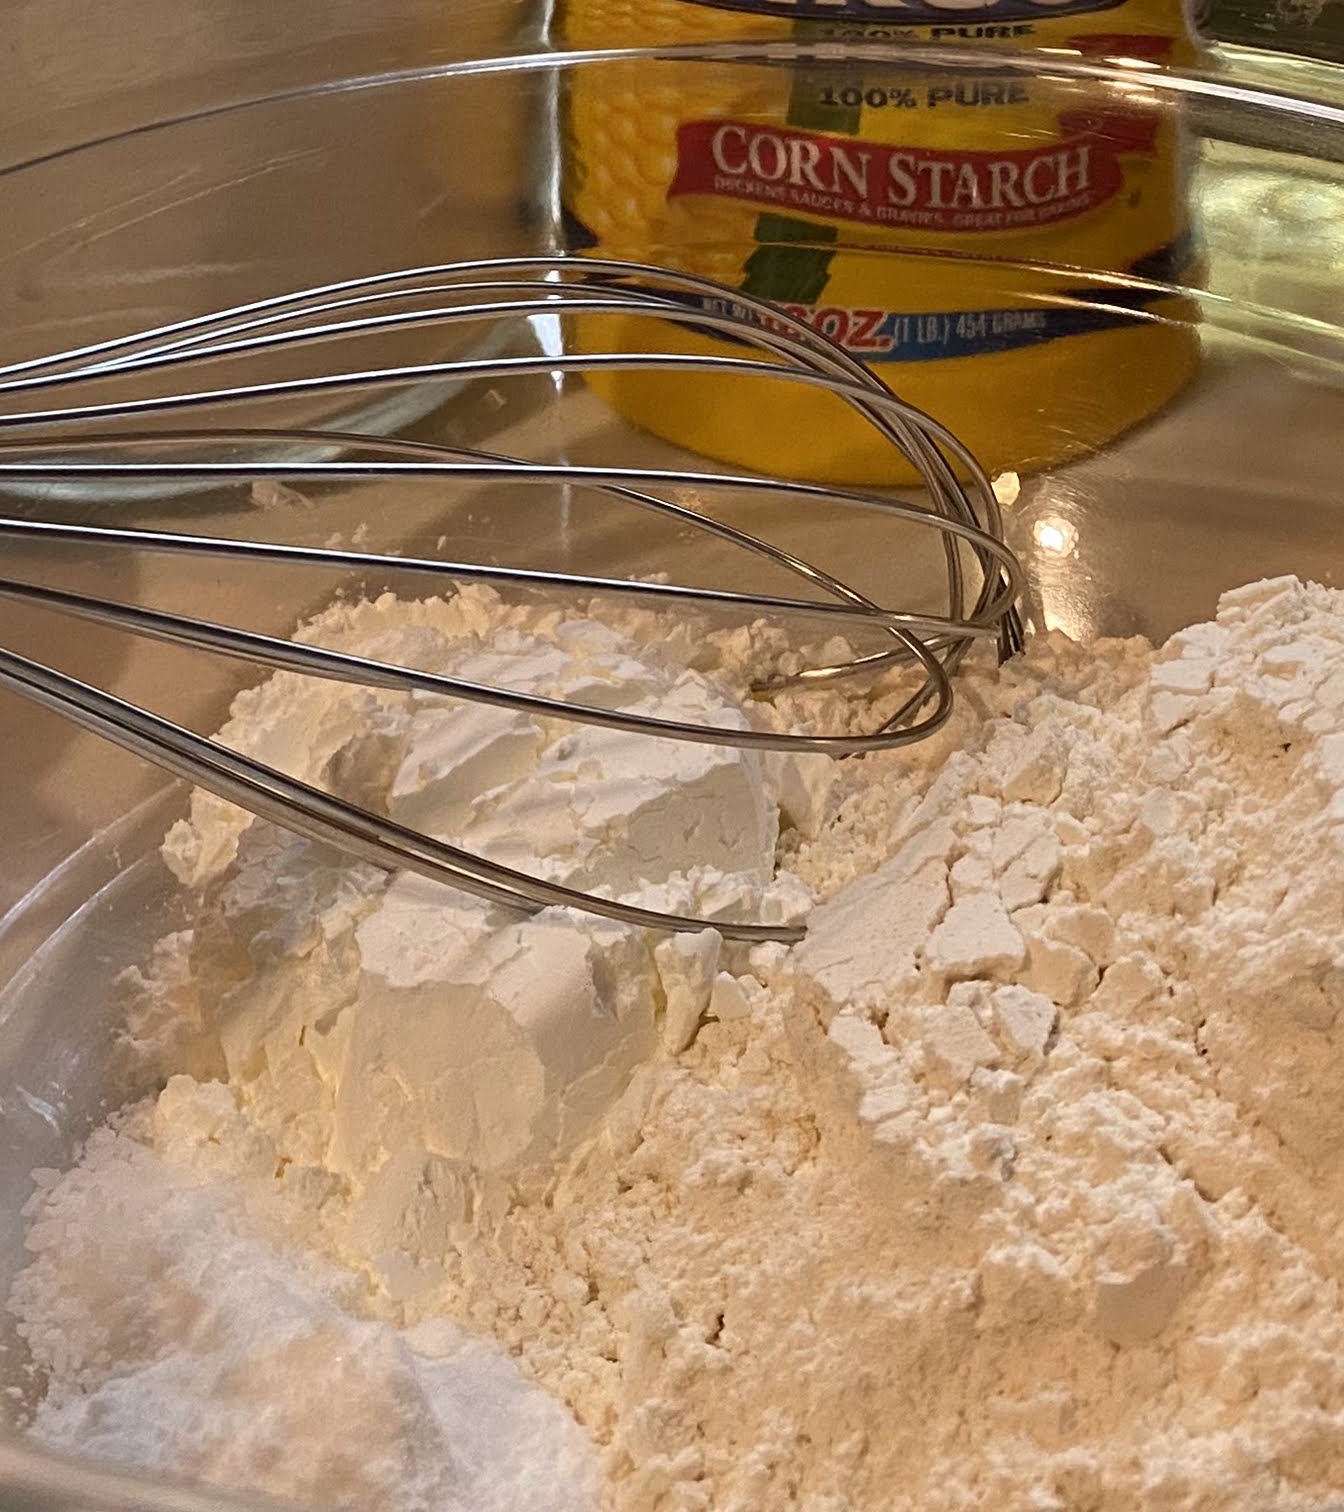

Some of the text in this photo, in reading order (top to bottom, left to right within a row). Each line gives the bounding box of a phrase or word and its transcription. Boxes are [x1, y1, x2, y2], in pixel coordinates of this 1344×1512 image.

[818, 82, 1030, 109] 100% PURE
[710, 124, 1092, 211] CORN STARCH
[956, 313, 986, 339] 454
[991, 310, 1048, 335] GRAMS
